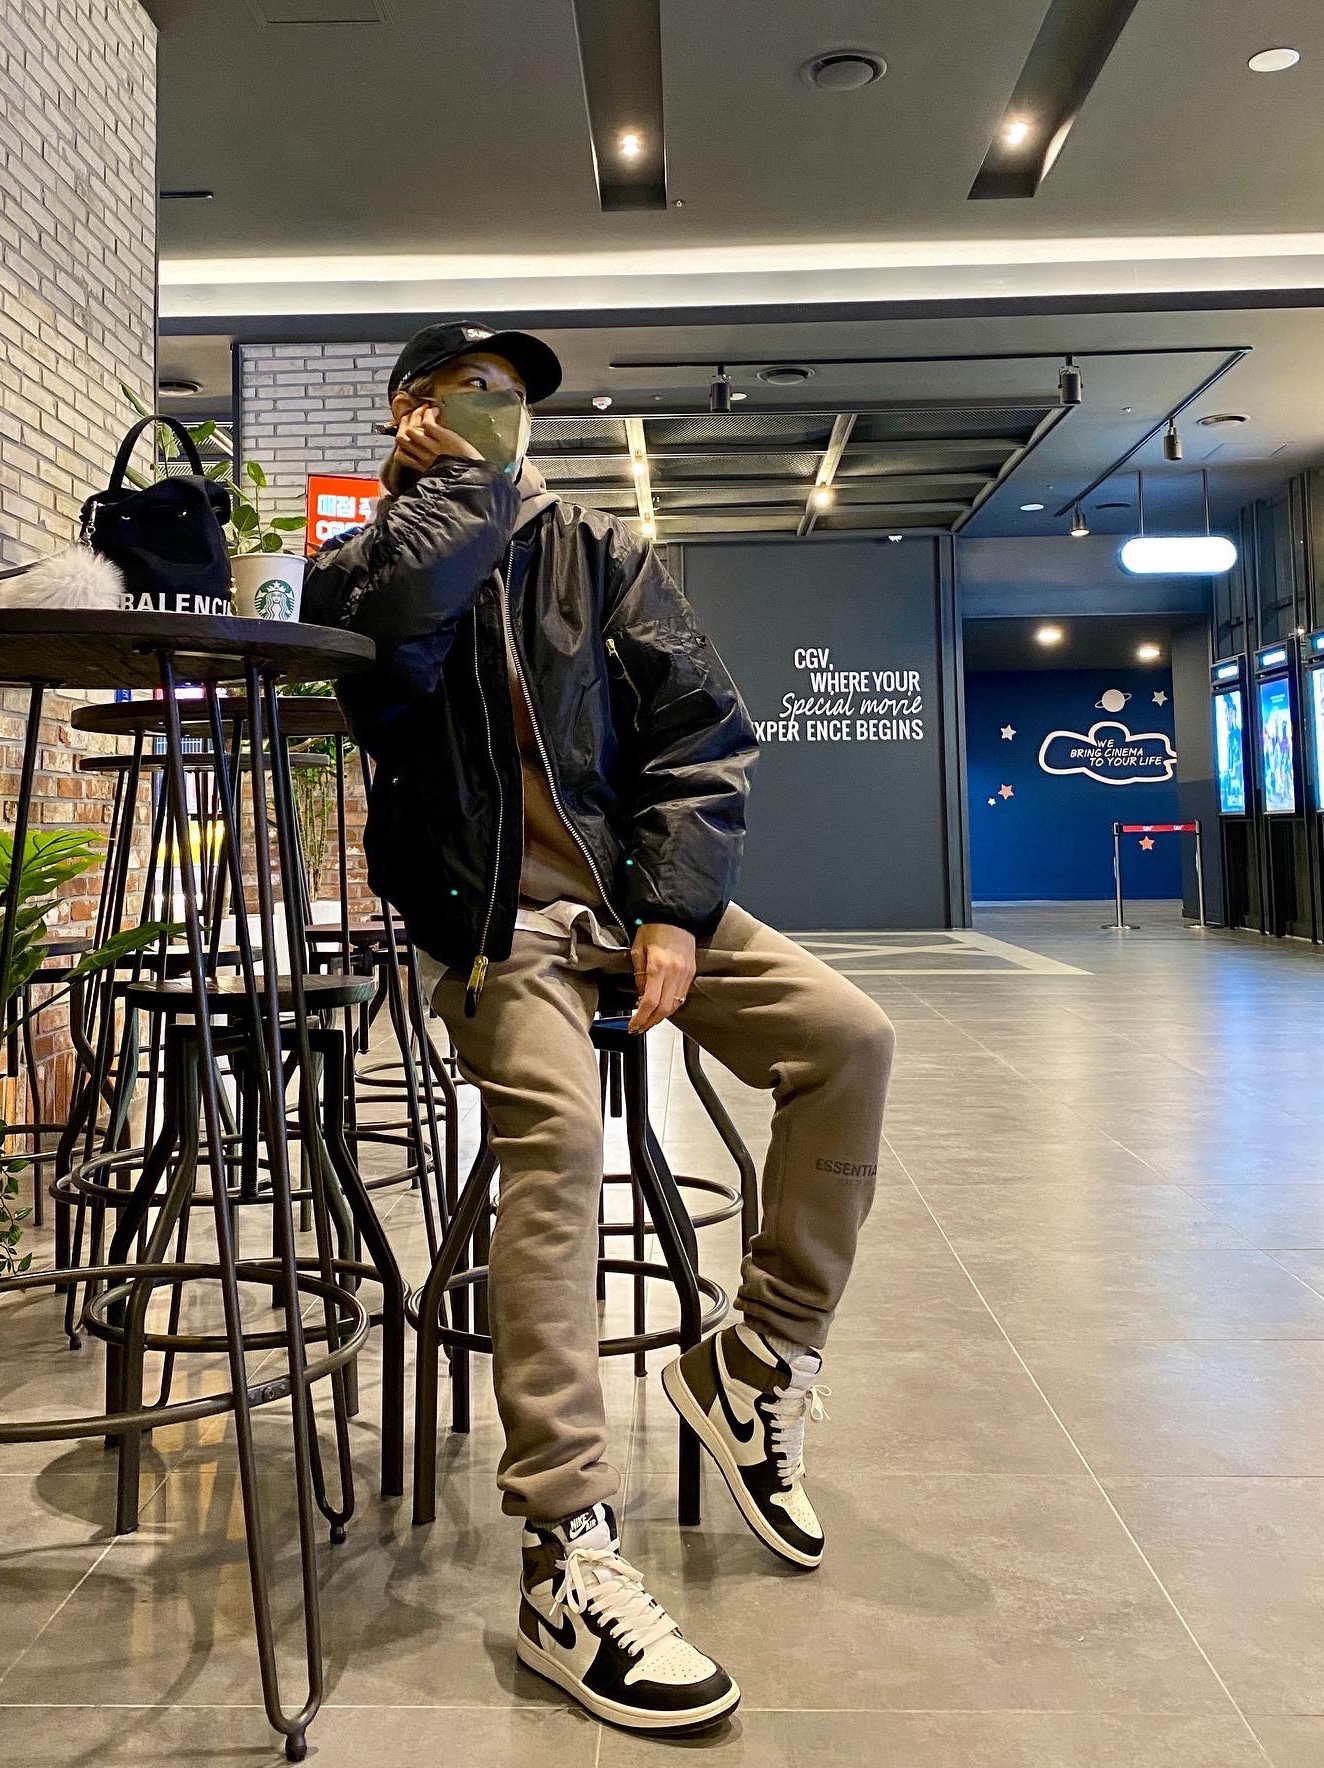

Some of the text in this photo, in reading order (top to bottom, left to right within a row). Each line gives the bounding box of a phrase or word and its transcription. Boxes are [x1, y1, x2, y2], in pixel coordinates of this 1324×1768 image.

[467, 328, 494, 339] Sup
[794, 648, 834, 671] CGV,
[810, 670, 921, 693] WHERE YOUR
[779, 690, 923, 726] Special movie
[752, 720, 800, 741] XPER
[856, 719, 924, 741] BEGINS
[1070, 747, 1144, 758] BRING CINEMA
[1097, 739, 1115, 748] WE
[1089, 756, 1163, 767] TO YOUR LIFE
[570, 1512, 589, 1531] NIKE
